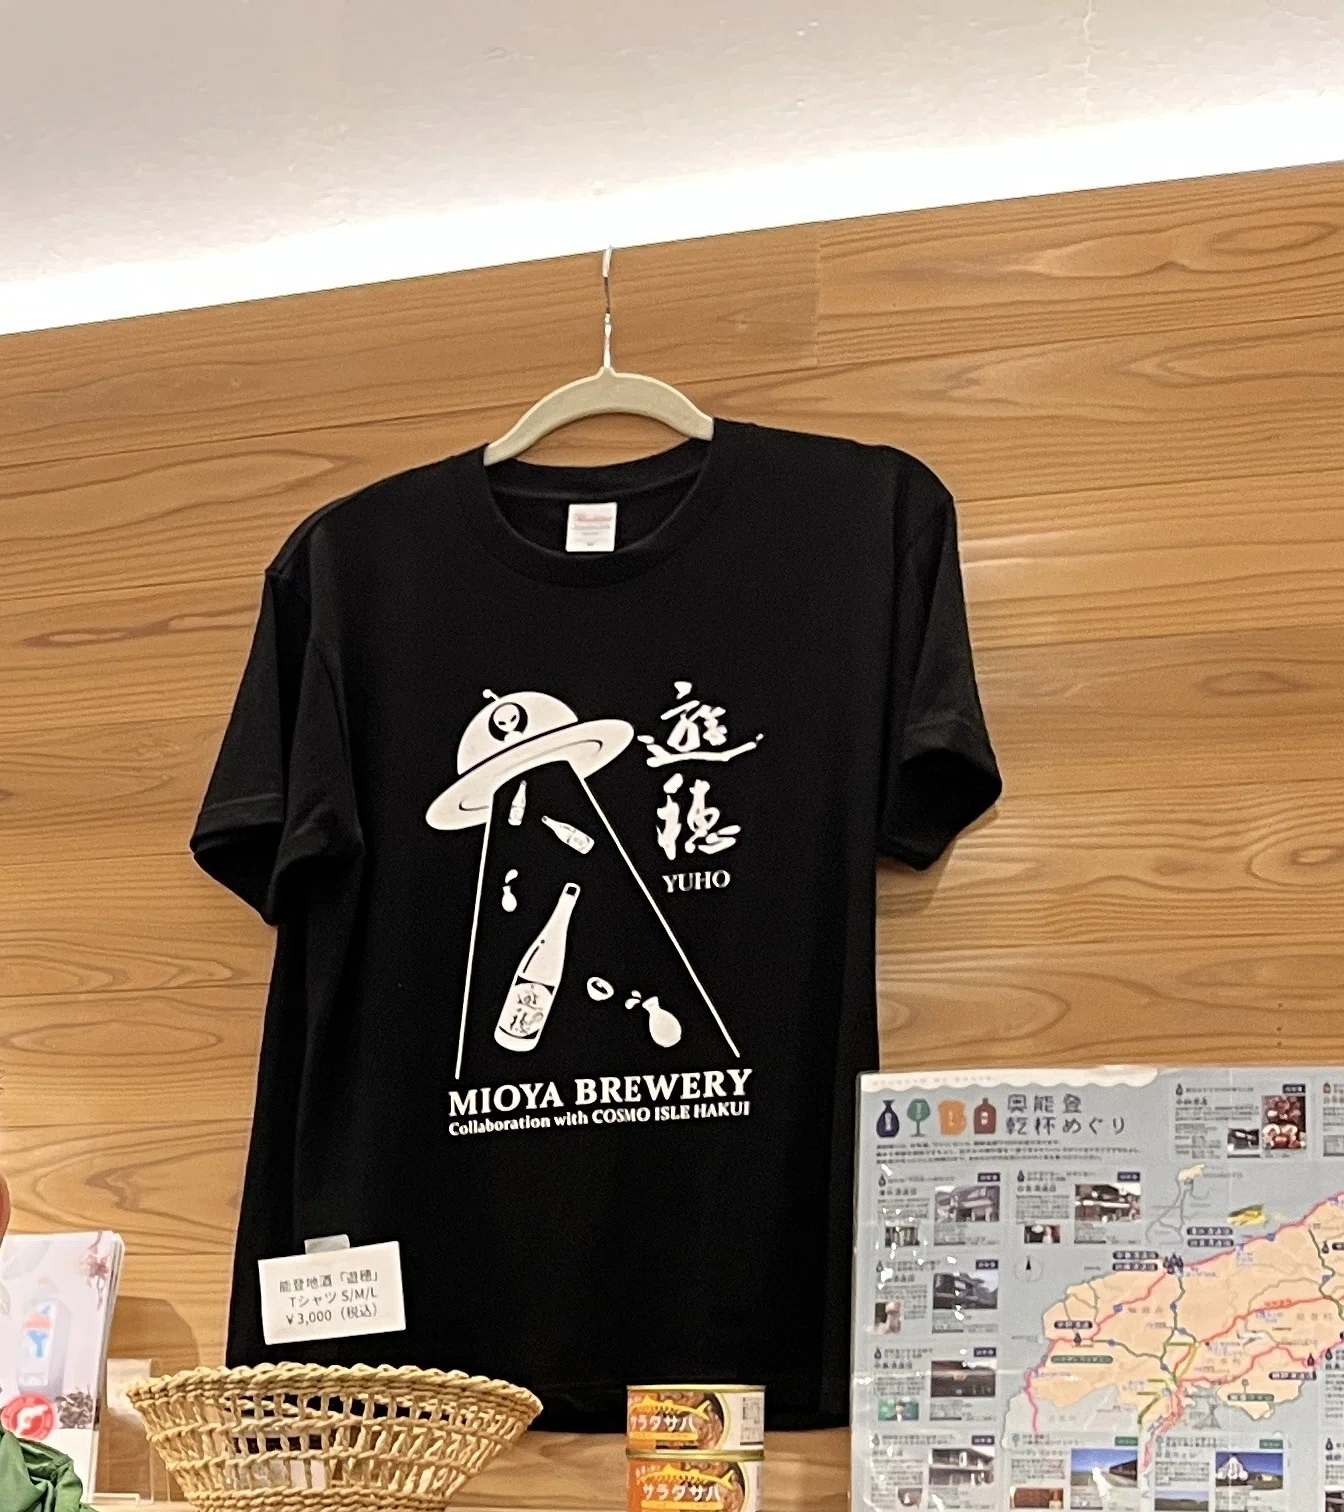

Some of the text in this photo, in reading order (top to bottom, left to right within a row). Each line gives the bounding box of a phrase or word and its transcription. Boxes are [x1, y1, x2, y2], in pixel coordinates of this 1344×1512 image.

[662, 870, 731, 893] YUHO
[448, 1069, 752, 1117] MIOYA BREWERY
[448, 1101, 750, 1136] Collaboration with COSMO ISLE HAKUI
[289, 1286, 378, 1307] Tシャツ S/M/L
